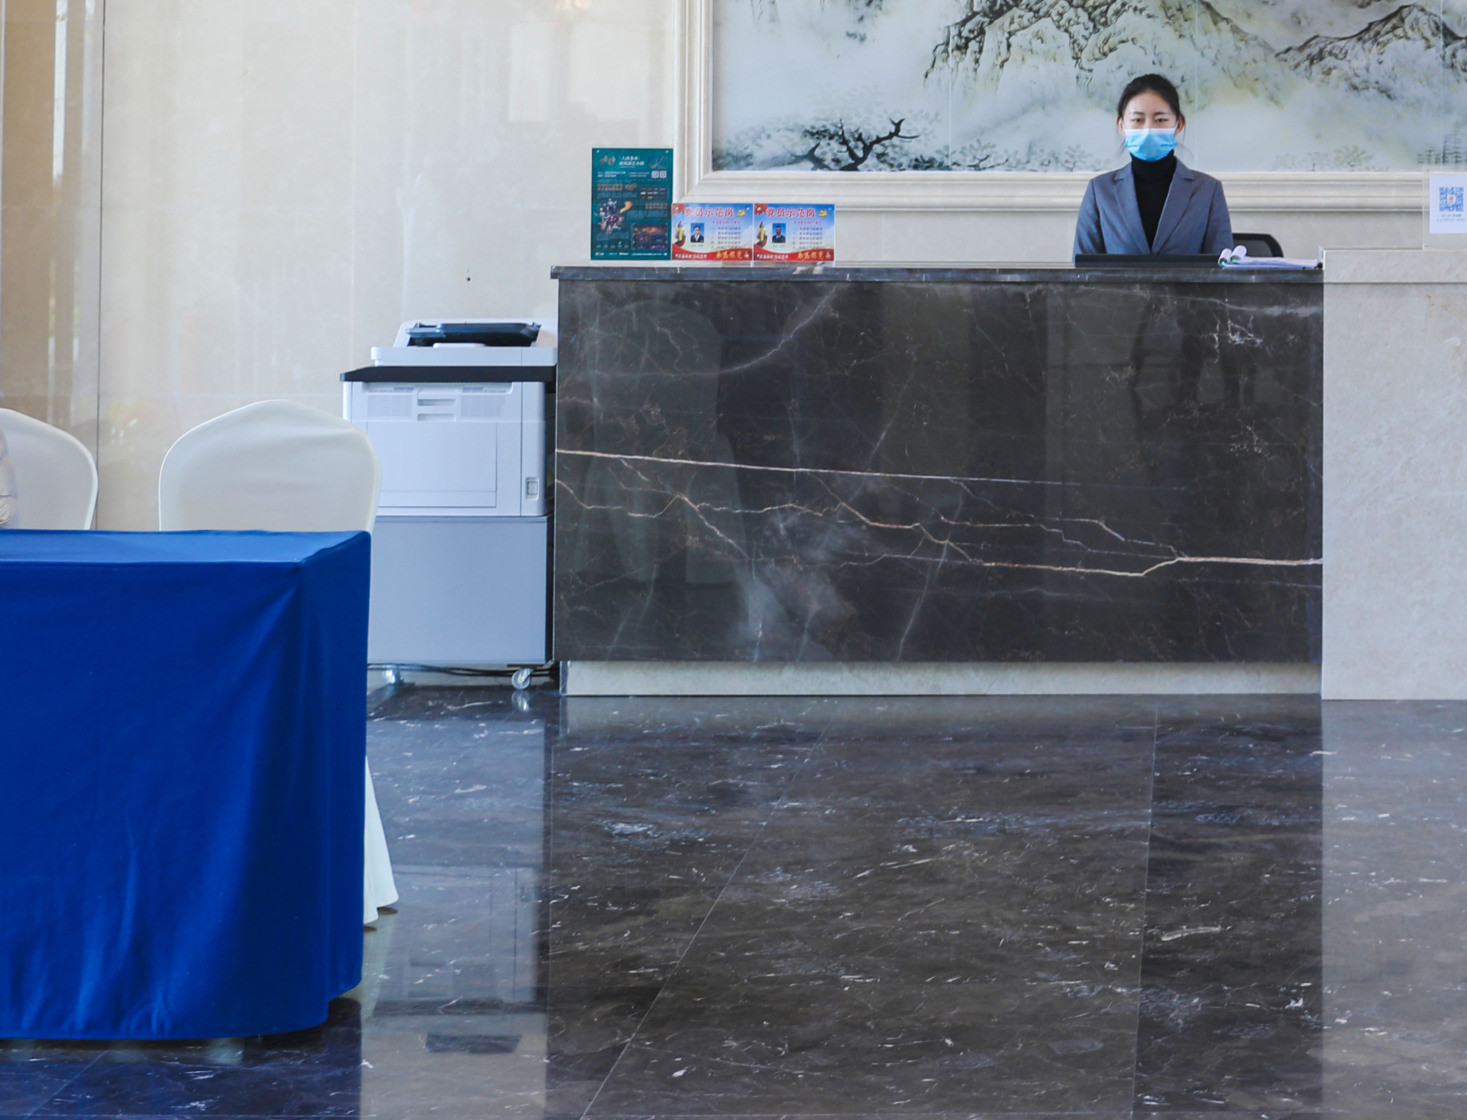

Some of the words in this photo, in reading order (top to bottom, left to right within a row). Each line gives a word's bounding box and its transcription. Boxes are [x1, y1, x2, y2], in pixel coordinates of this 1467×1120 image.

[684, 207, 735, 218] 党员示范岗
[766, 207, 816, 218] 党员示范岗
